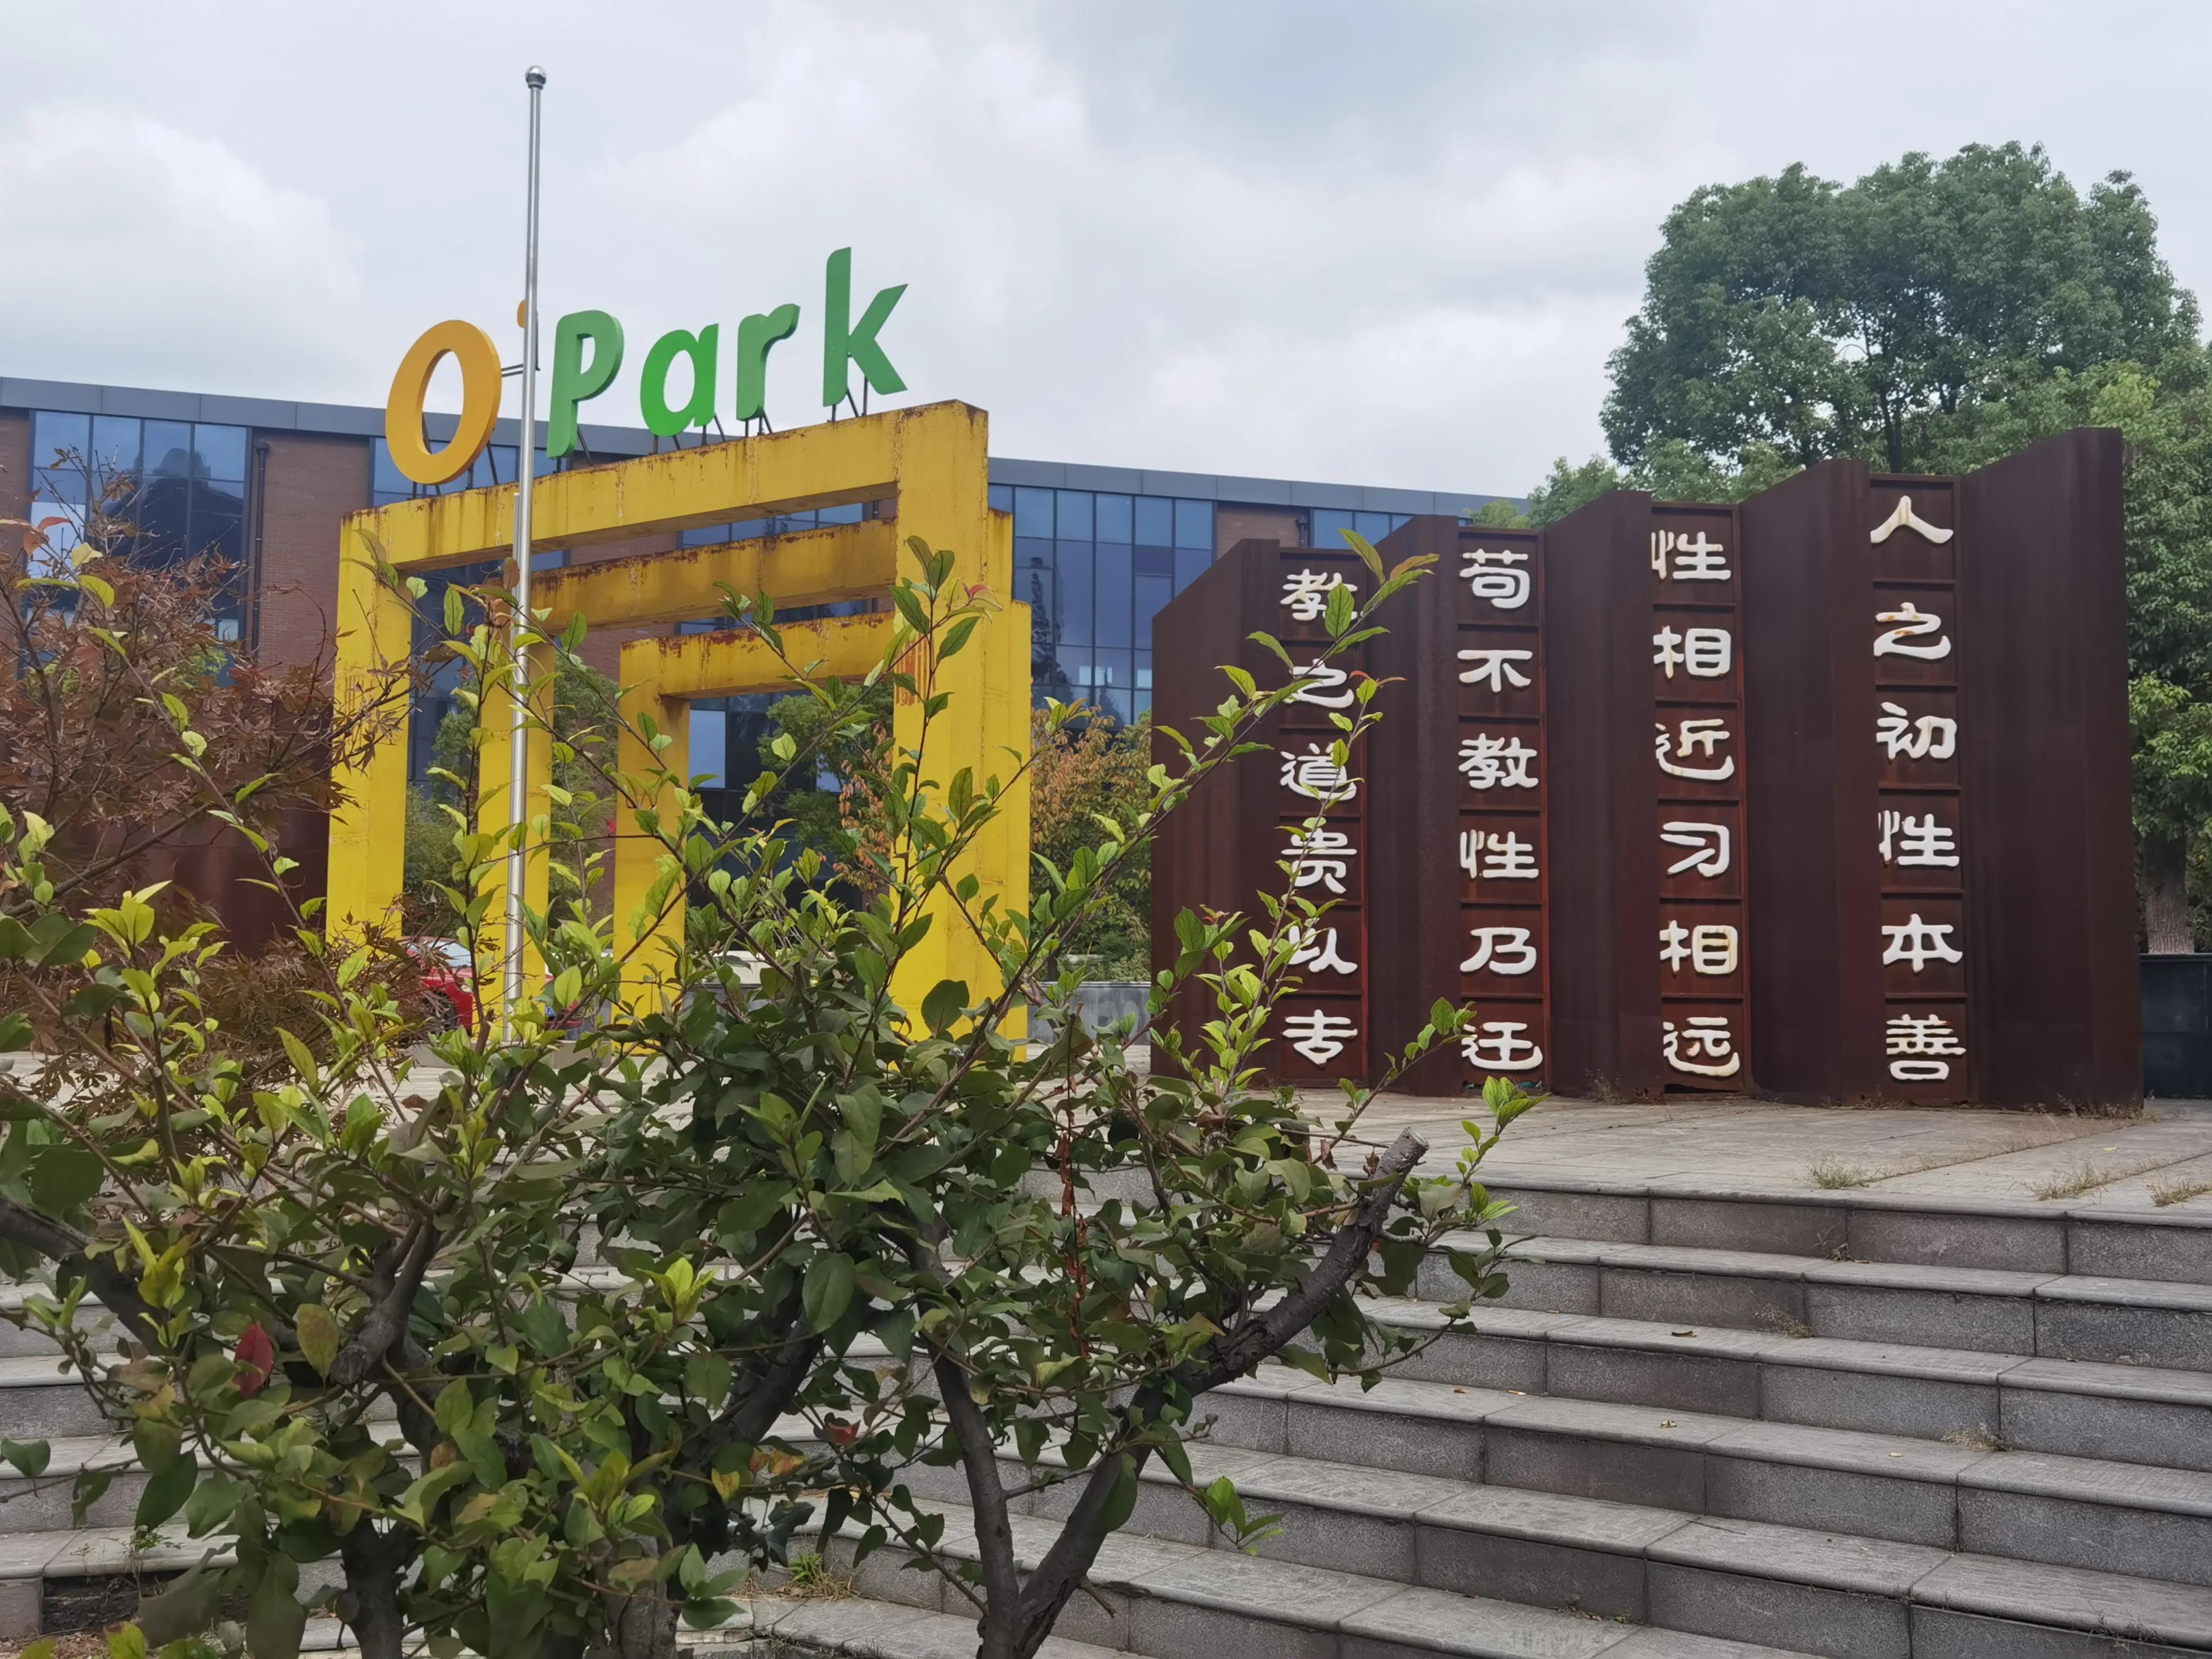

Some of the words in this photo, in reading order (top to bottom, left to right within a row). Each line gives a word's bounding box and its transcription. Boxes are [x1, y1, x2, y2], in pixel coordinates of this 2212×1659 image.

[1651, 530, 1739, 1076] 性相近习相远
[1870, 495, 1966, 1080] 人之初性本善
